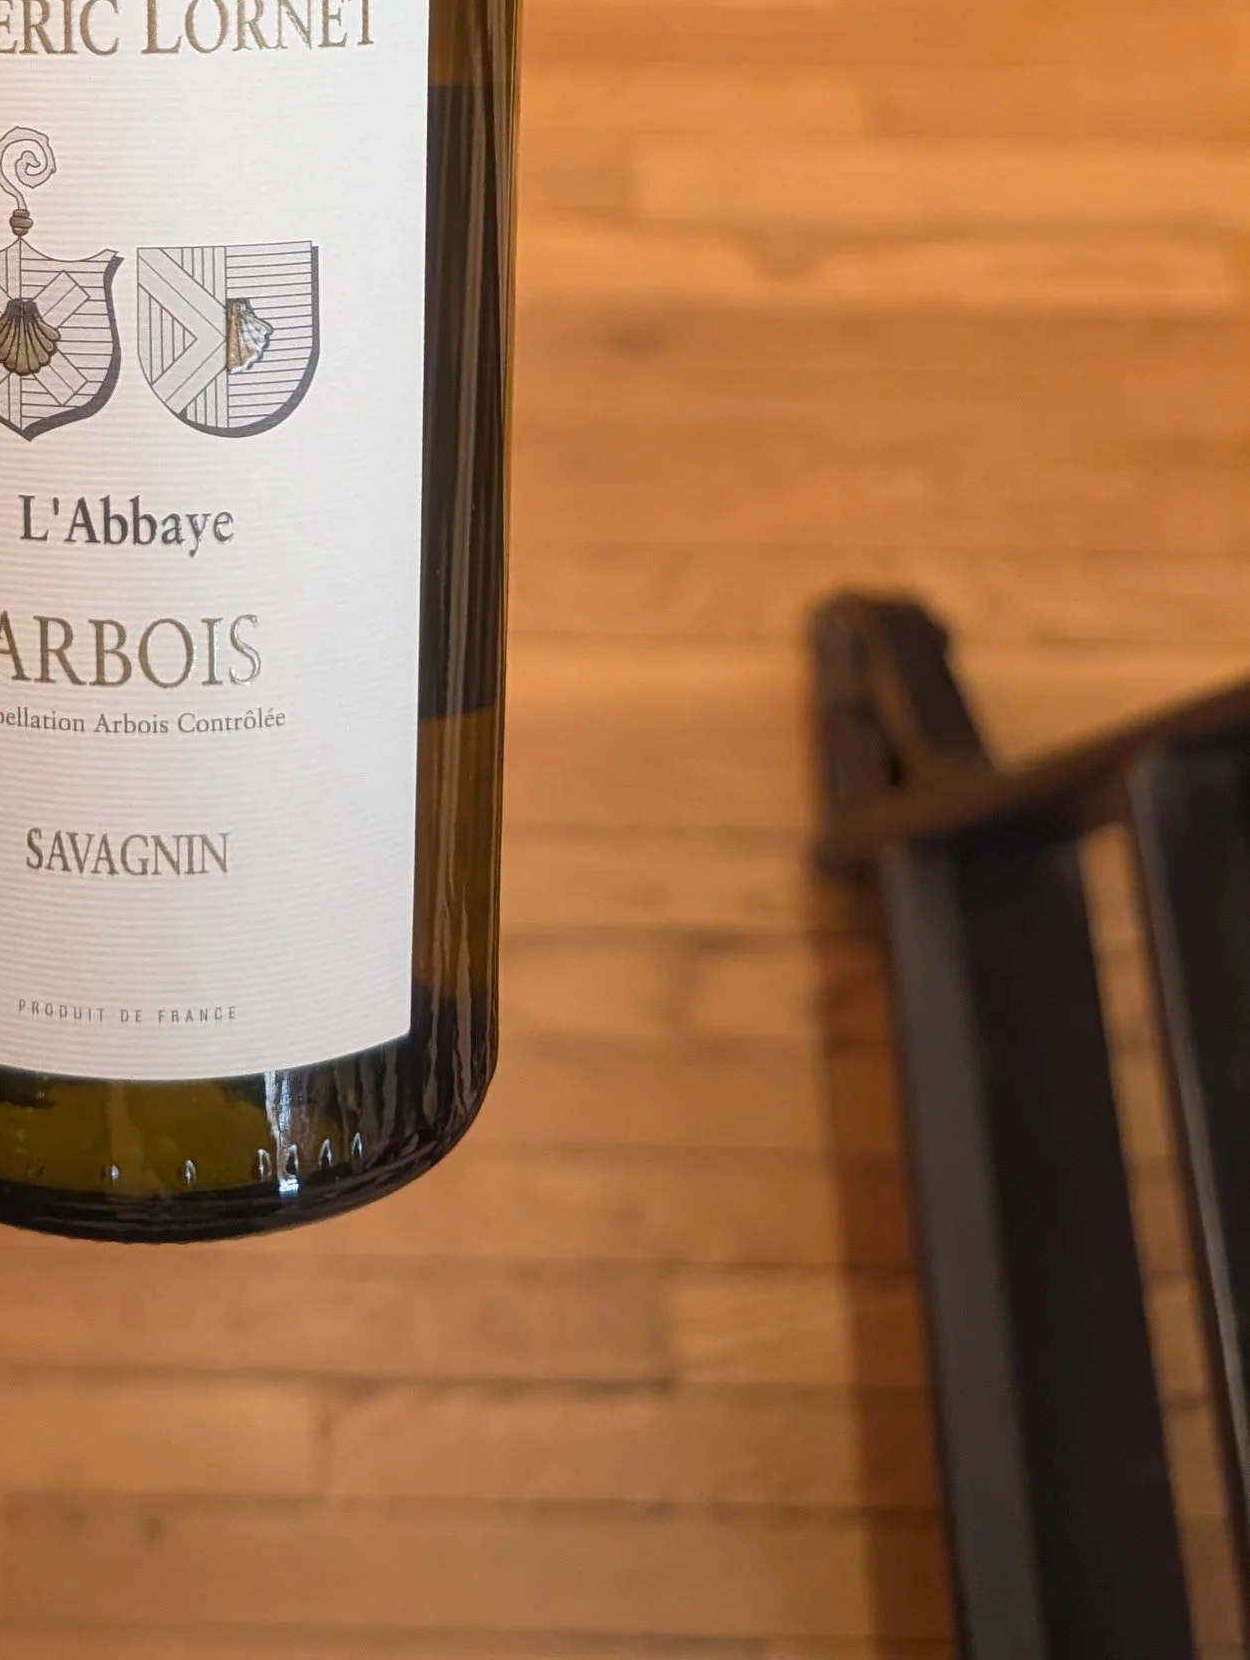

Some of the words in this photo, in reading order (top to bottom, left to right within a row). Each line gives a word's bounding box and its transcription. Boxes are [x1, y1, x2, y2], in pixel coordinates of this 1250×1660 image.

[17, 494, 235, 557] L'Abbaye
[94, 712, 169, 735] Arbois
[177, 707, 286, 734] Contrôlée
[26, 827, 229, 876] SAVAGNIN
[18, 999, 106, 1023] PRODUIT
[120, 1009, 144, 1023] DE
[157, 1005, 237, 1023] FRANCE
